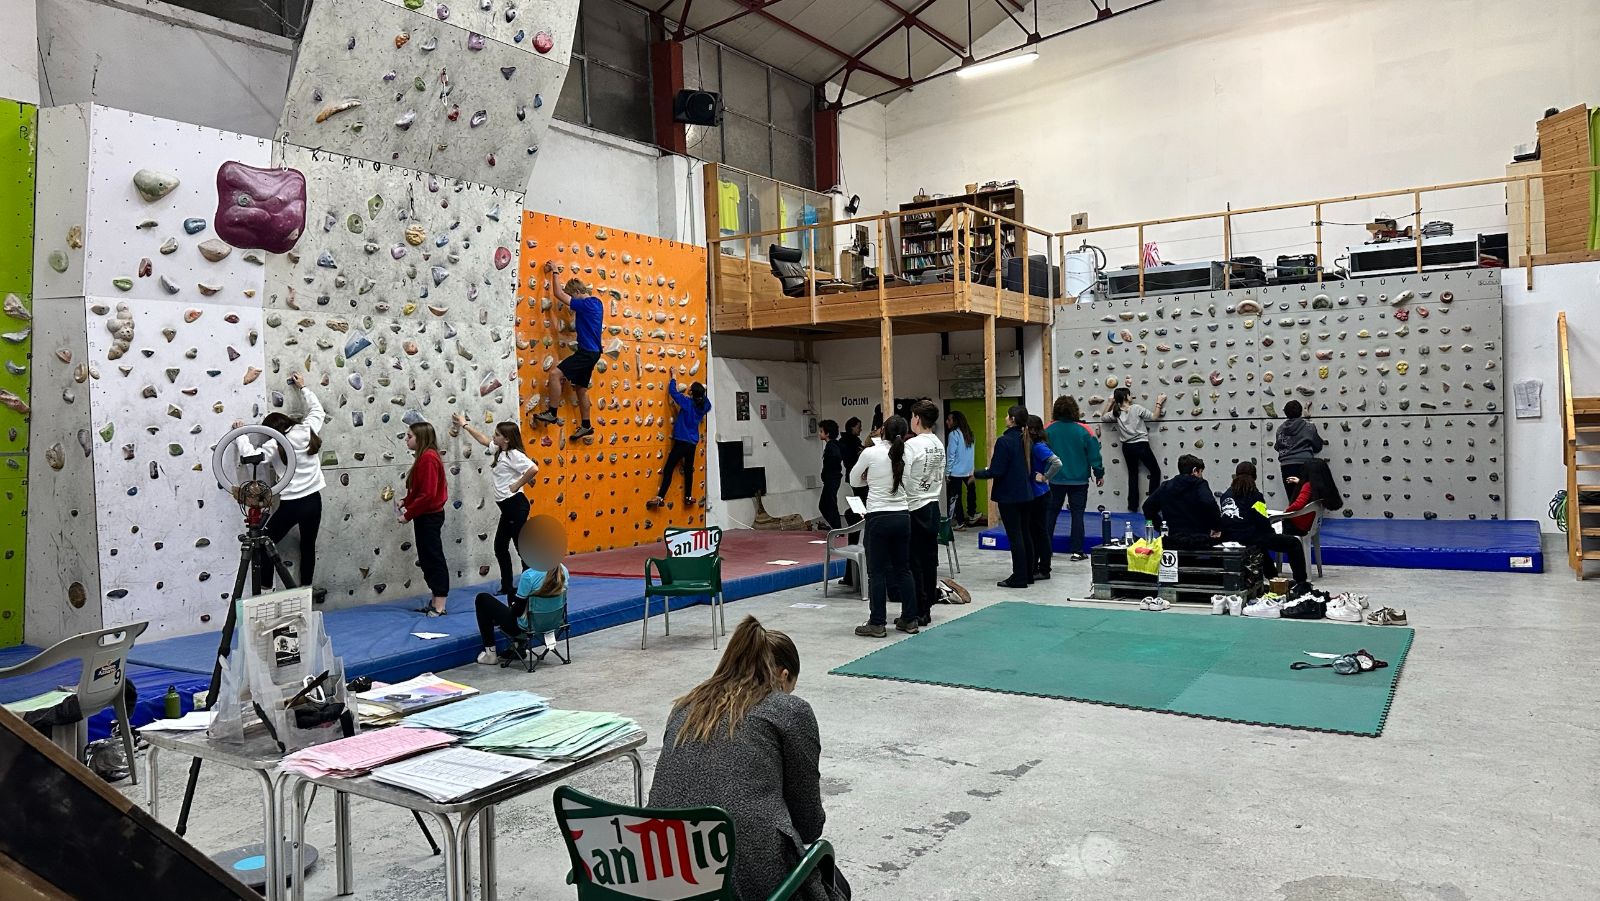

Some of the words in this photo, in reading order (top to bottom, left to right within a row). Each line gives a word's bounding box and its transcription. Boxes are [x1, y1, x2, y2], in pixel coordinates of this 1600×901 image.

[236, 132, 243, 140] G
[257, 138, 265, 146] H
[311, 150, 320, 161] K
[328, 153, 334, 162] L
[343, 157, 351, 166] M
[358, 160, 364, 168] N
[389, 165, 394, 173] P
[416, 170, 422, 181] R
[466, 182, 472, 190] V
[491, 187, 499, 196] X
[503, 189, 508, 198] Y
[515, 196, 523, 205] Z
[544, 214, 549, 222] E
[511, 269, 517, 277] 6
[1488, 270, 1494, 278] Z
[511, 283, 516, 293] 7
[114, 669, 121, 685] 9
[611, 817, 622, 844] 1
